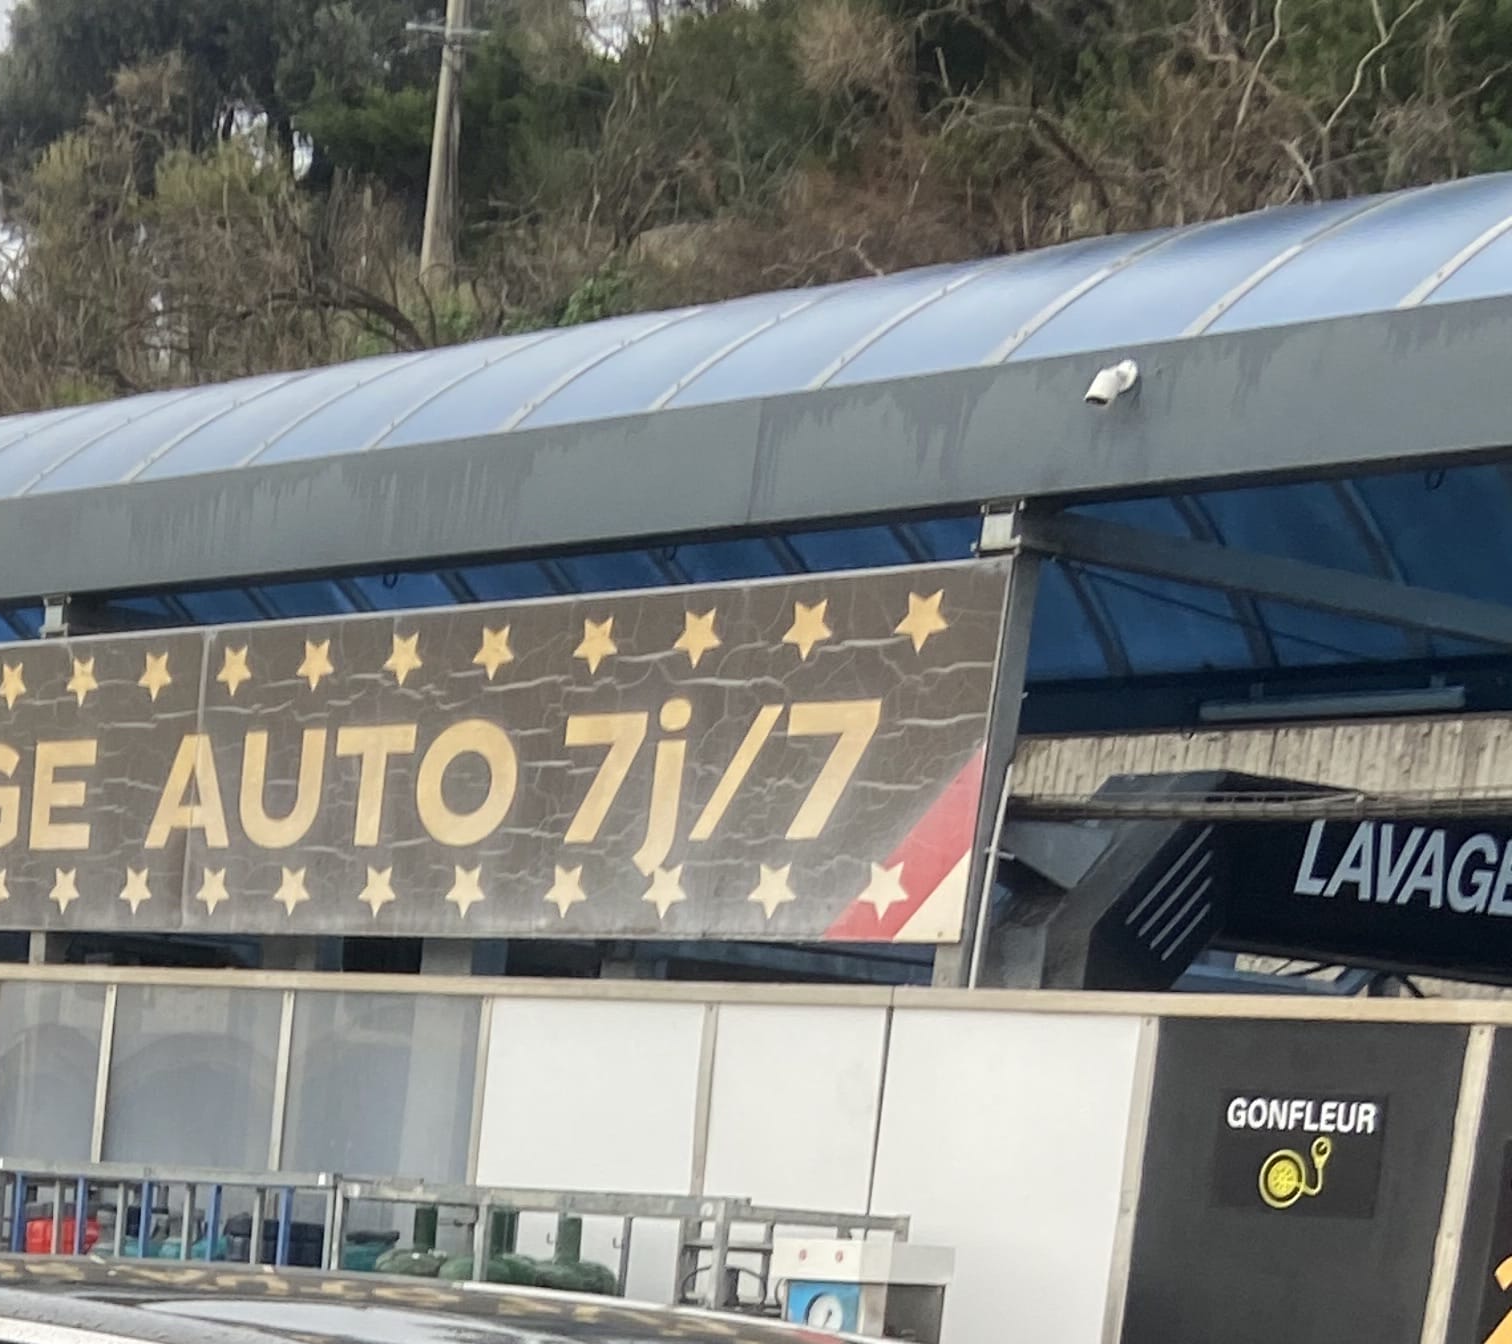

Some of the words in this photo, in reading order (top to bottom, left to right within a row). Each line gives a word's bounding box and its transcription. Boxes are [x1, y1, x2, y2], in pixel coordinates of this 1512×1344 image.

[144, 718, 518, 850] AUTO
[564, 698, 883, 876] 7j/7
[1226, 1096, 1377, 1134] GONFLEUR
